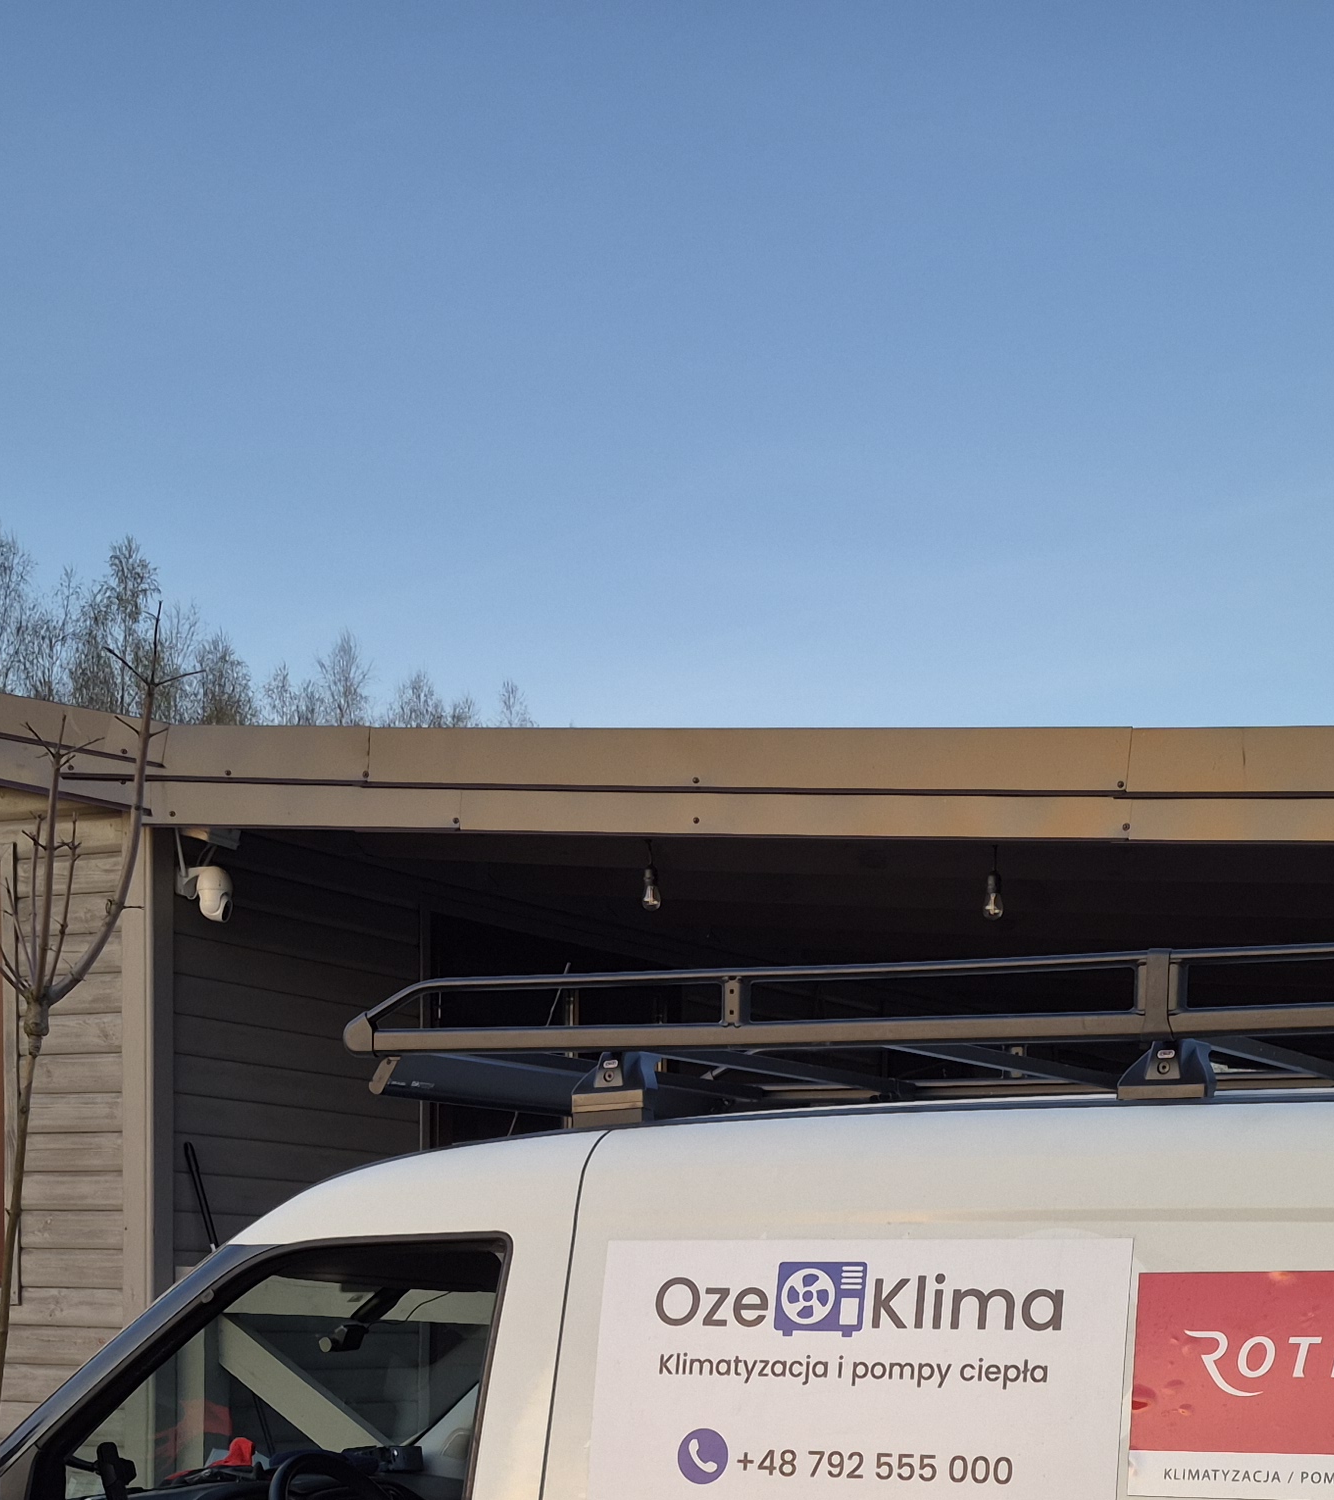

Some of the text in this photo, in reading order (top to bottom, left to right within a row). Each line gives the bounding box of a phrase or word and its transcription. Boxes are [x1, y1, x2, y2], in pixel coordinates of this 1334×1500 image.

[654, 1272, 1065, 1332] Oze Klima
[658, 1352, 1049, 1391] Klimatyzacja i pompy ciepła
[736, 1448, 1013, 1485] +48 792 555 000
[1163, 1467, 1281, 1484] KLIMATYZACJA
[1287, 1471, 1295, 1485] /
